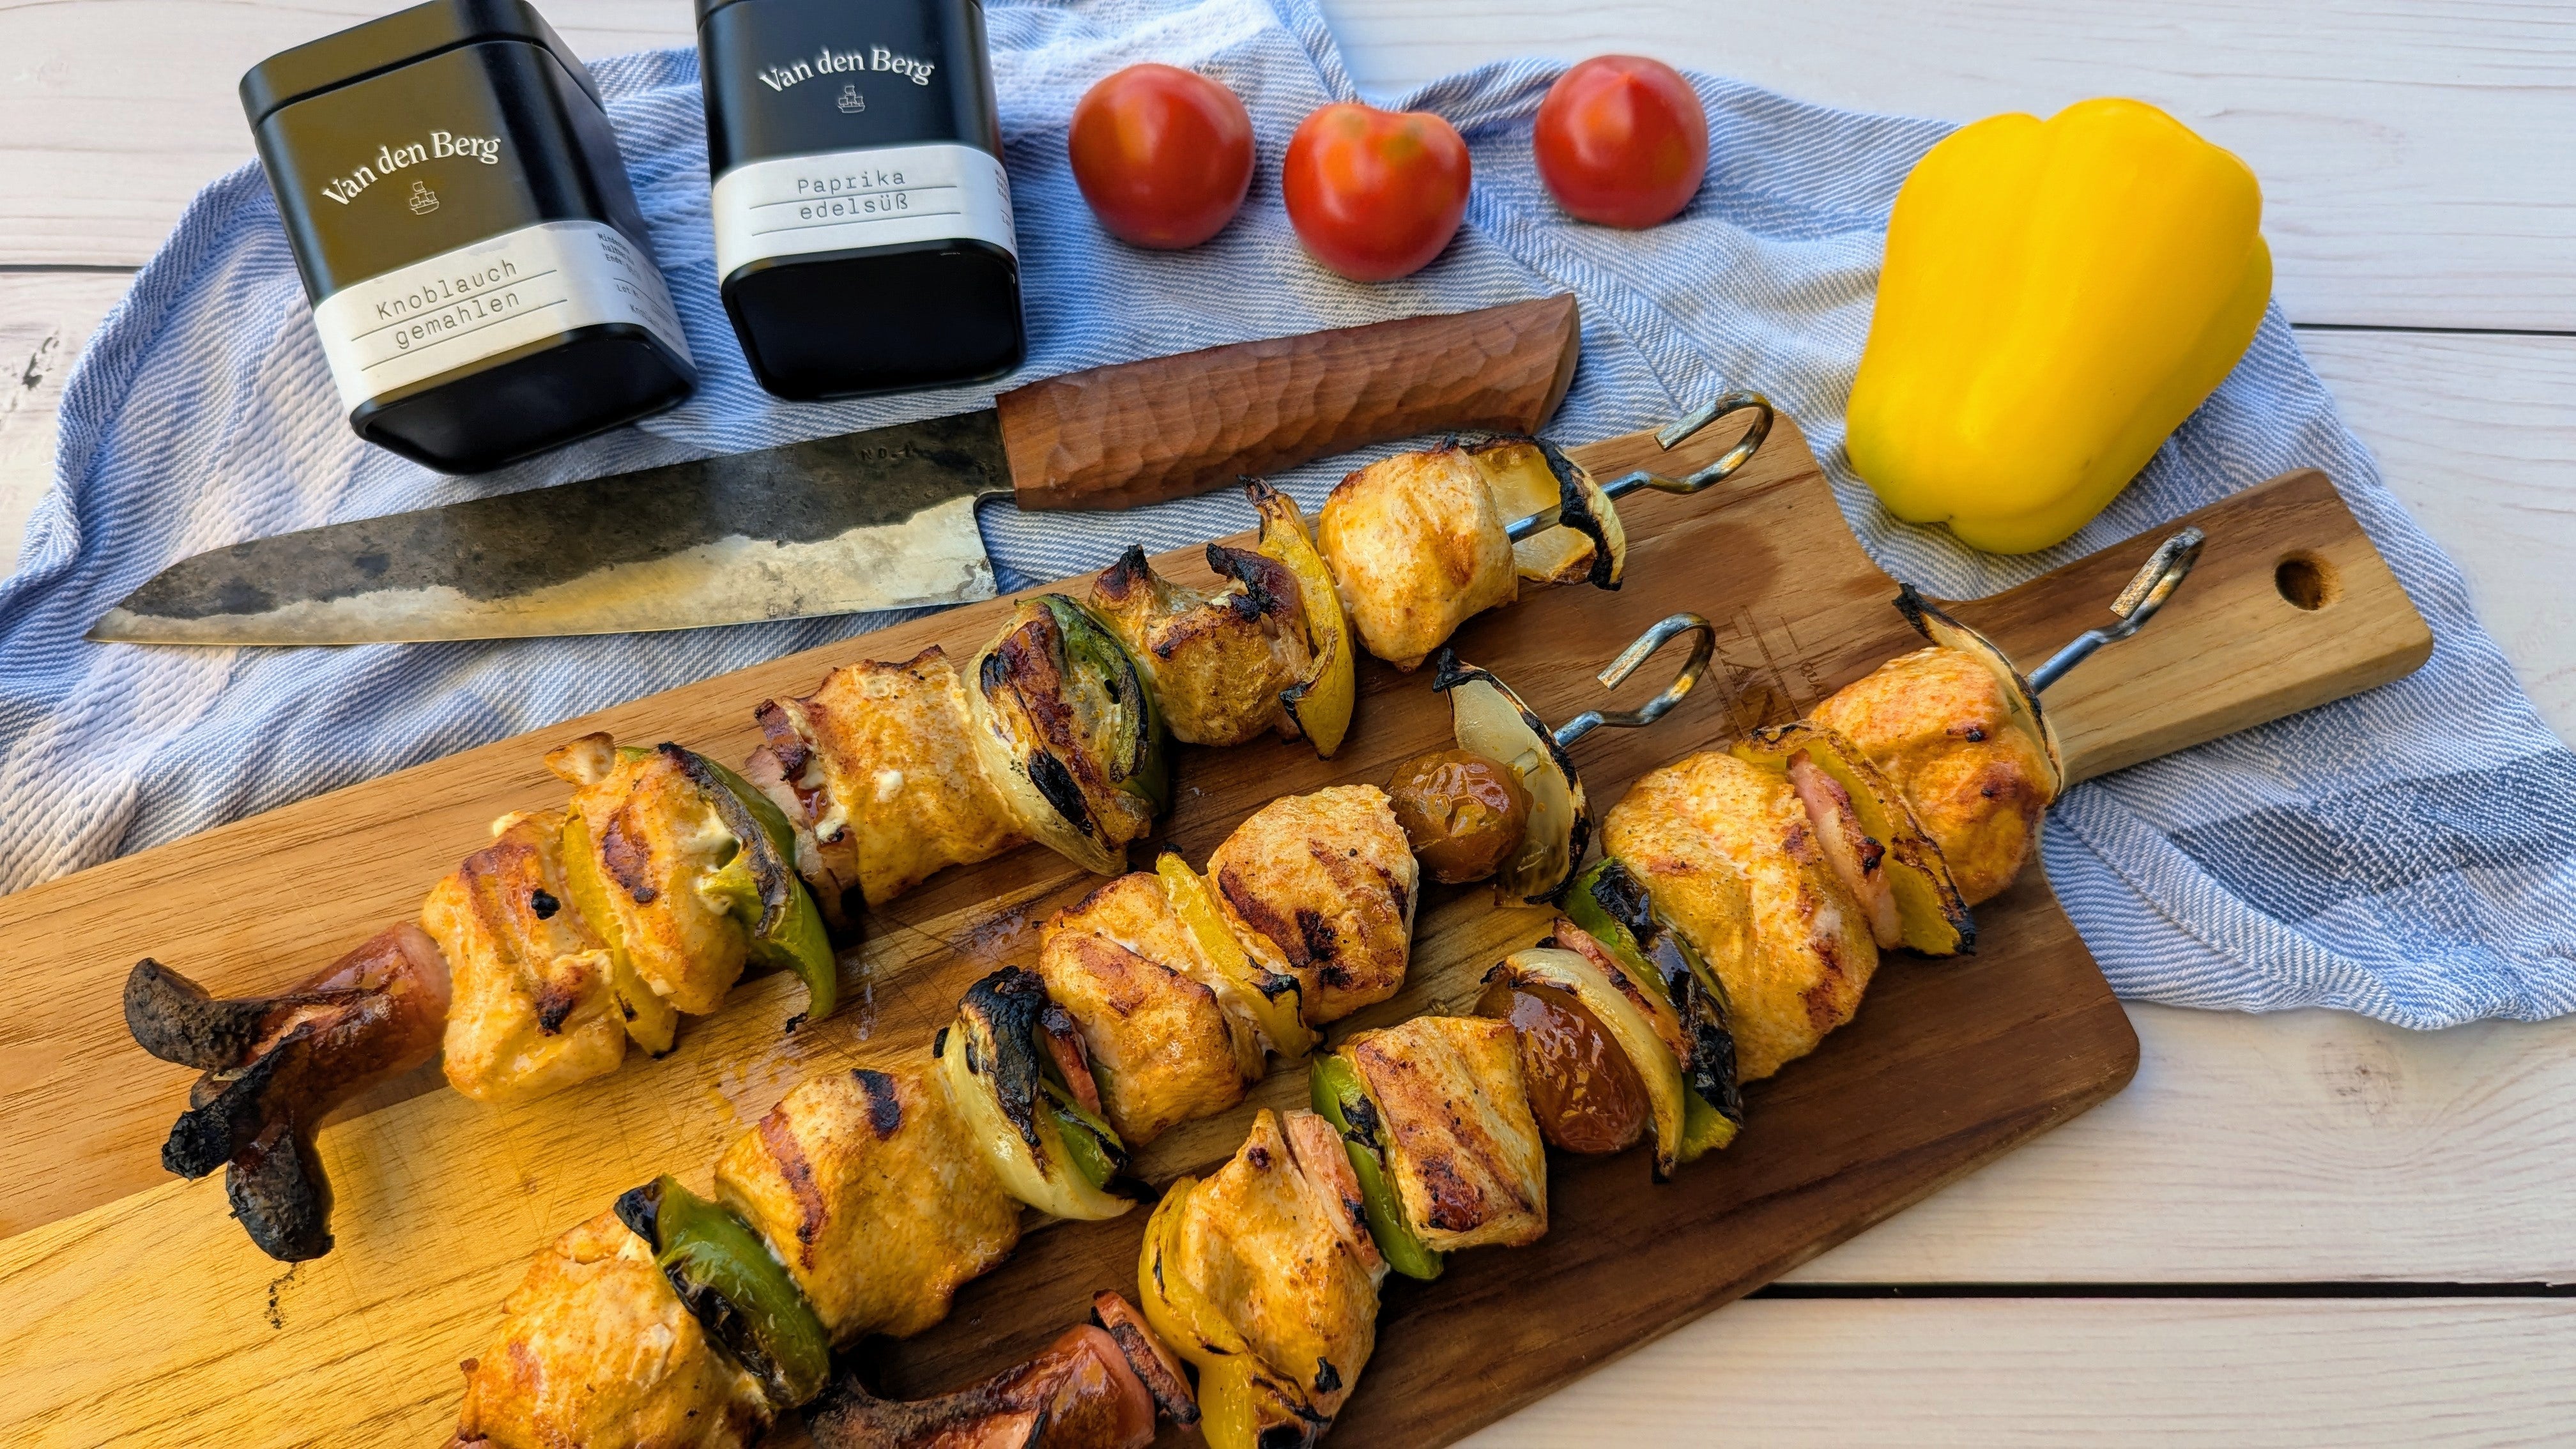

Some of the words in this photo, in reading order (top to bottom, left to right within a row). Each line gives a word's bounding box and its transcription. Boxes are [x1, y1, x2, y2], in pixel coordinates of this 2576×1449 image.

[759, 63, 815, 92] Van
[817, 49, 866, 75] den
[871, 49, 935, 86] Berg
[322, 166, 378, 205] Van
[378, 138, 429, 174] den
[431, 131, 502, 165] Berg
[798, 170, 906, 195] Paprika
[800, 193, 908, 220] edelsüß
[376, 259, 517, 320] Knoblauch
[395, 292, 519, 349] gemahlen
